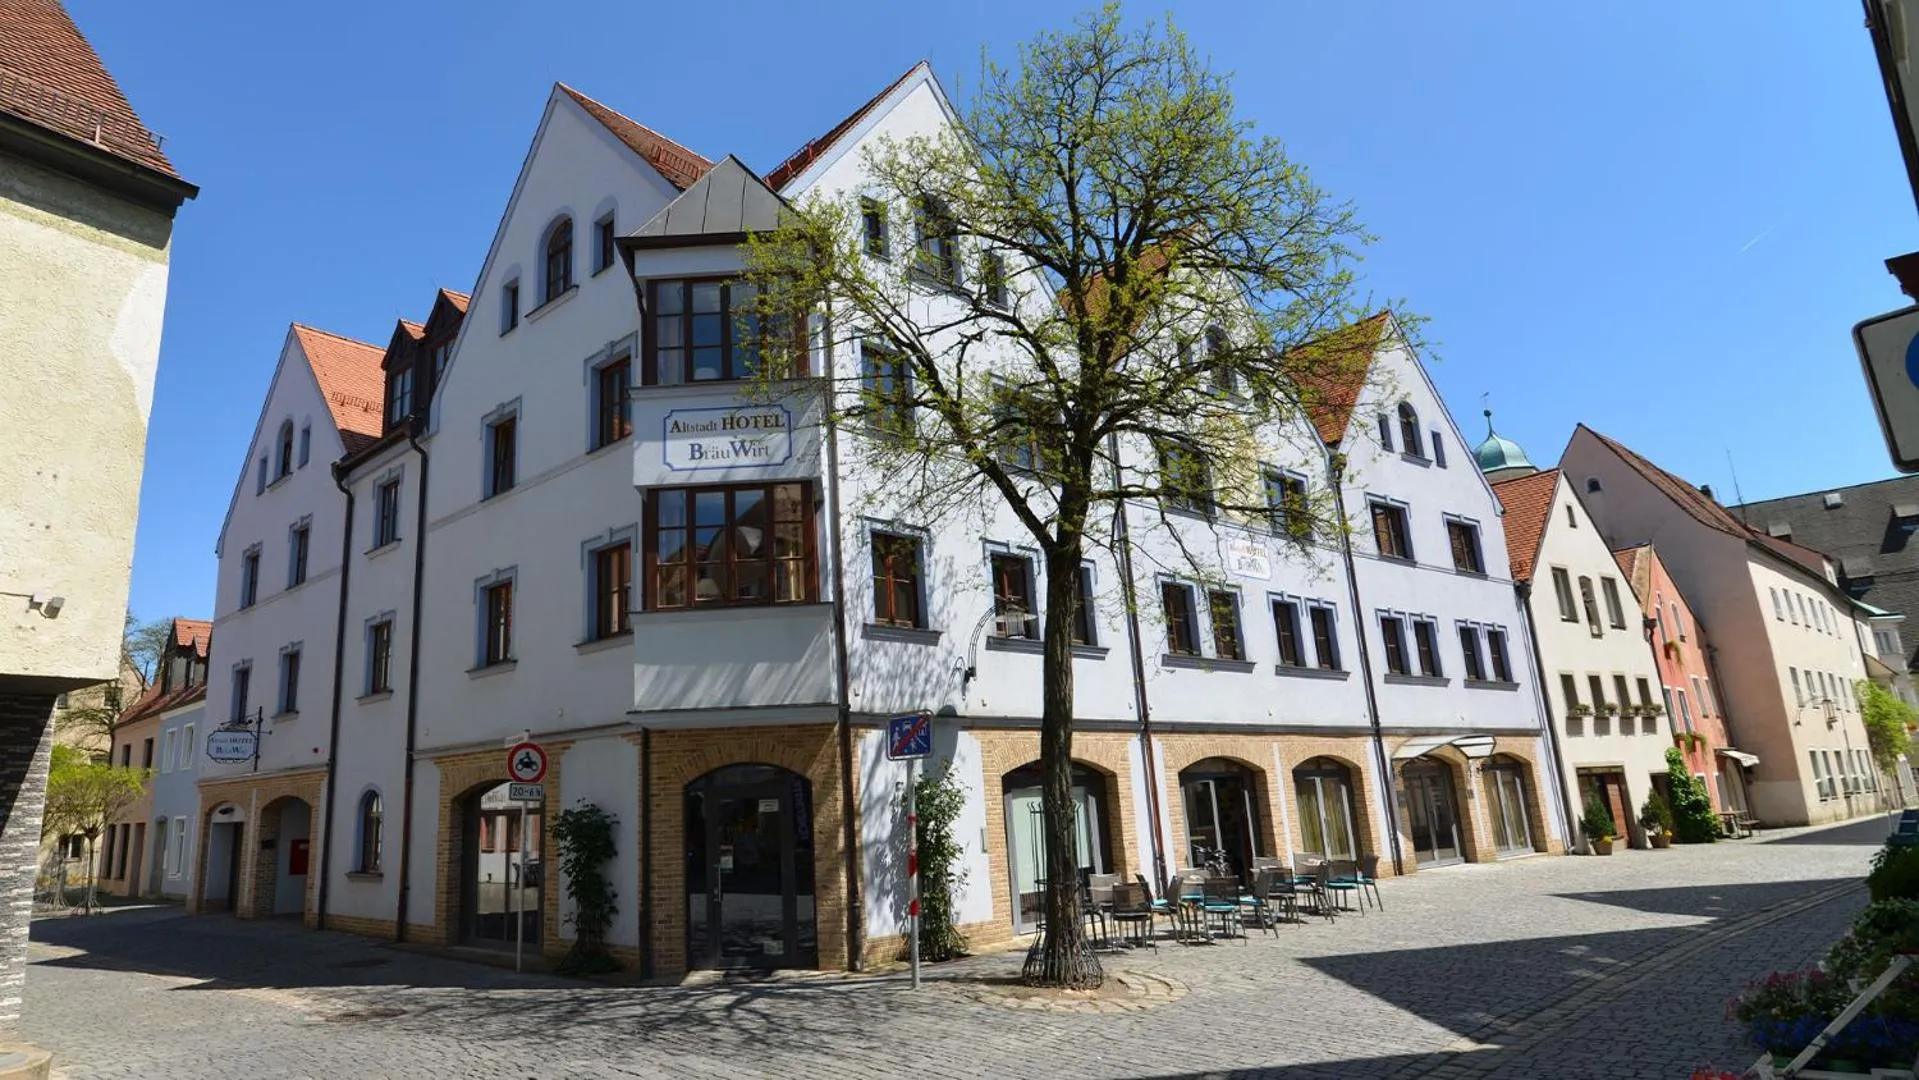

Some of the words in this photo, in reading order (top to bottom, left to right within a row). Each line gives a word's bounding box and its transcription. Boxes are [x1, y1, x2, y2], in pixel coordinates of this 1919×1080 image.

[669, 419, 717, 433] Altstadt
[721, 414, 785, 430] HOTEL
[689, 438, 769, 461] BräuWirt
